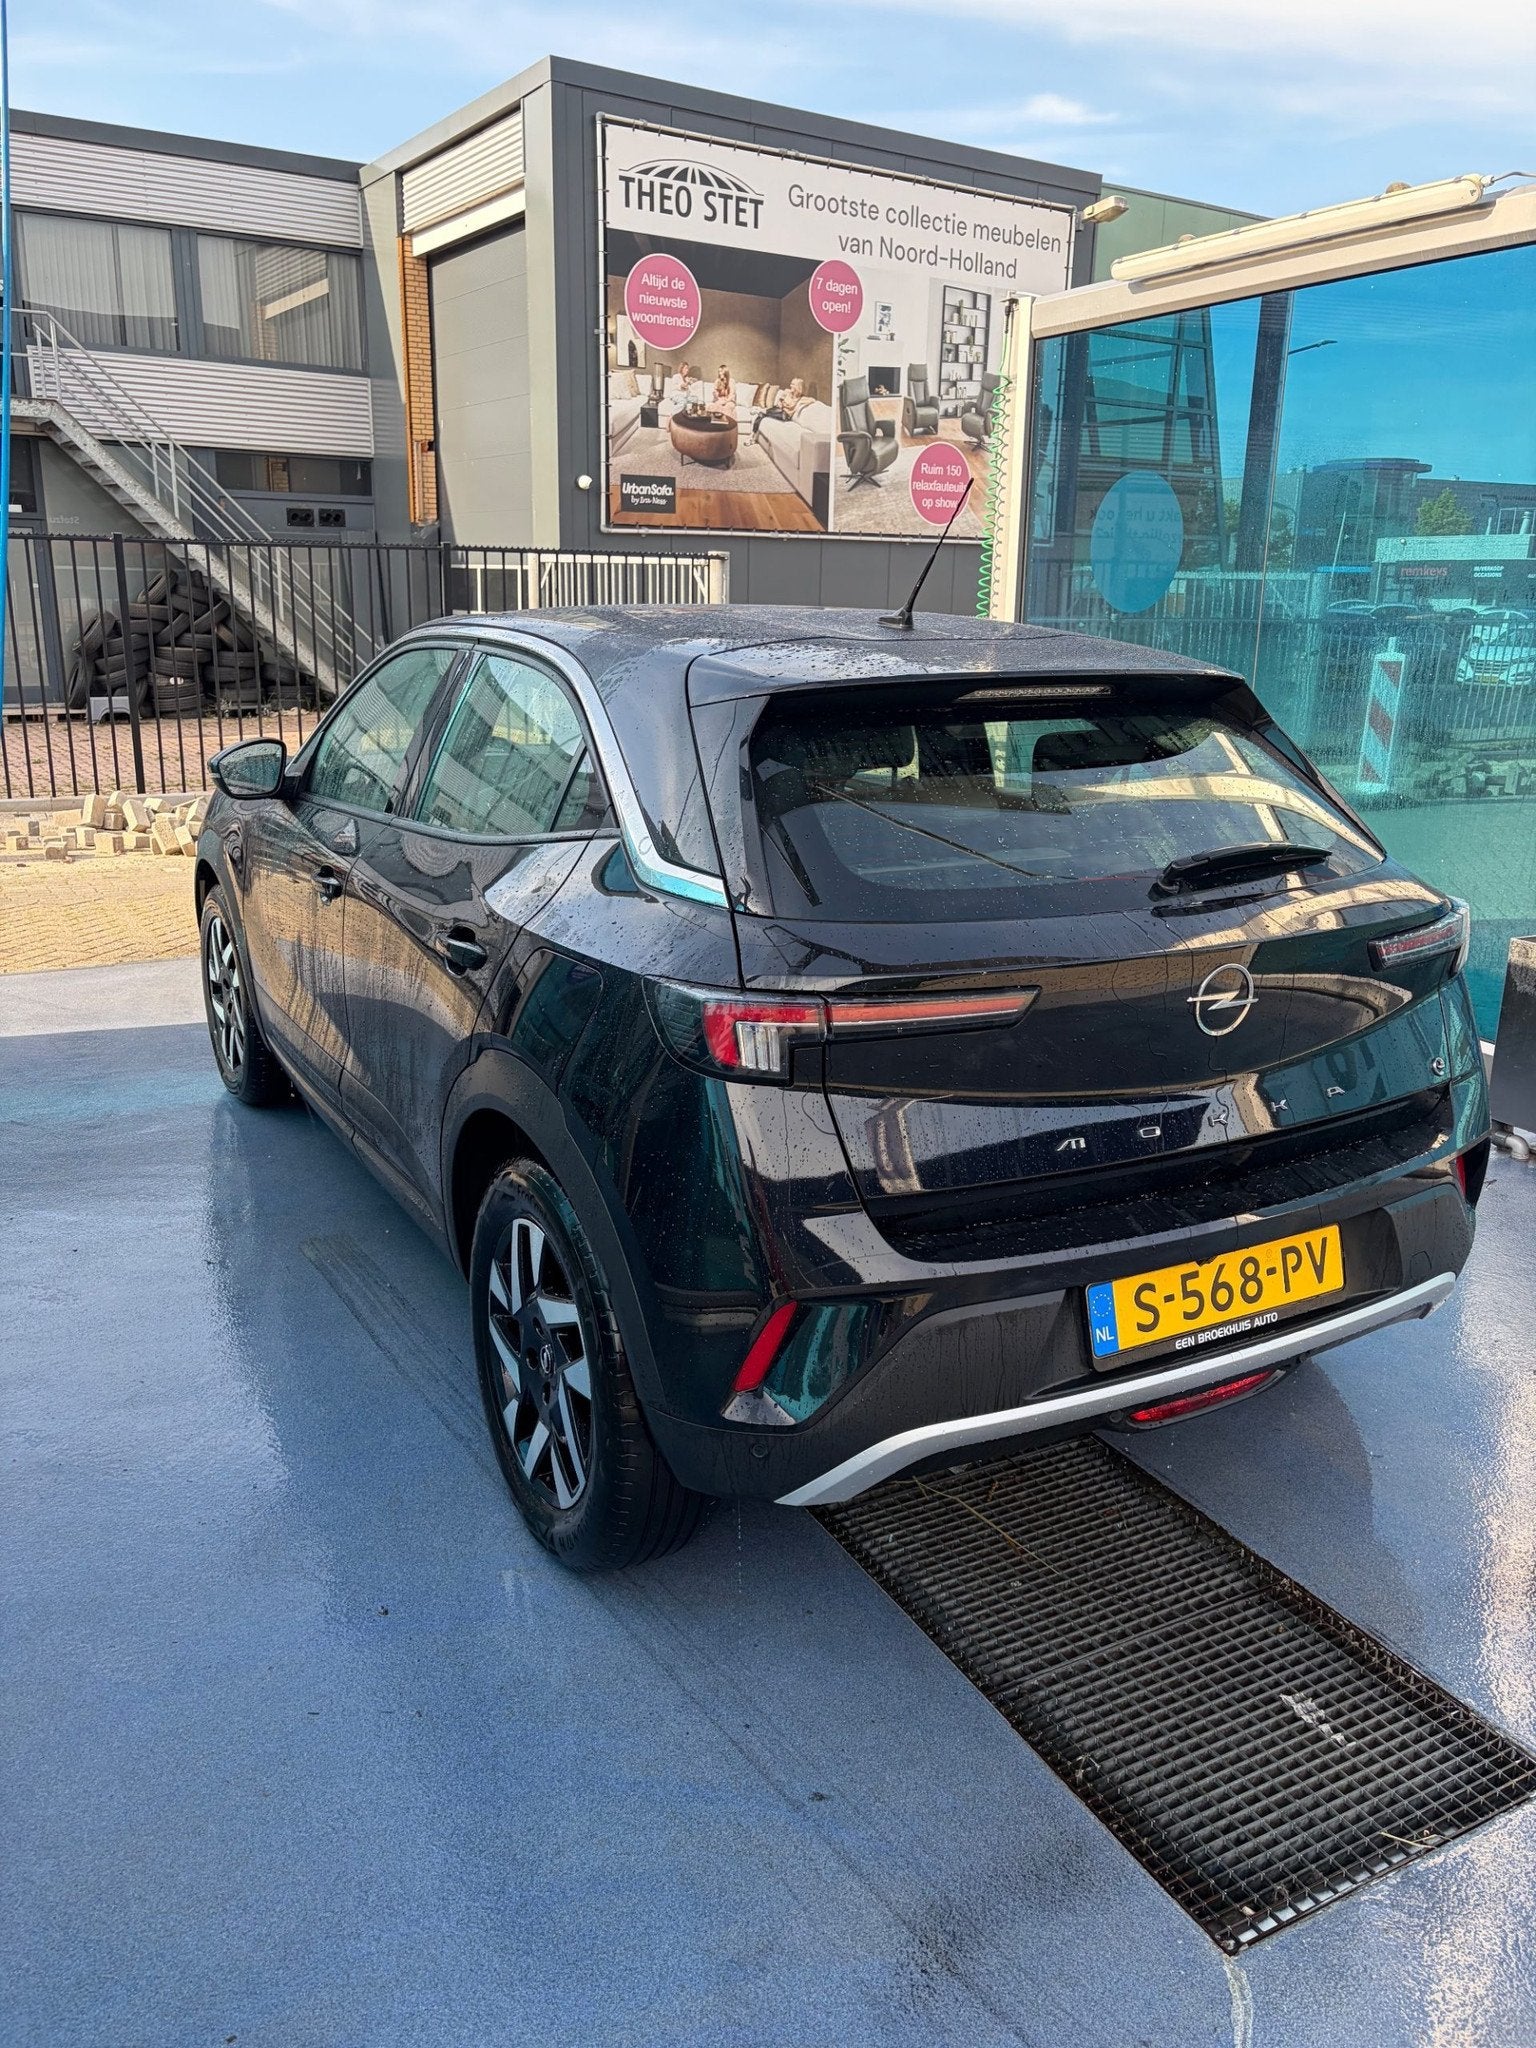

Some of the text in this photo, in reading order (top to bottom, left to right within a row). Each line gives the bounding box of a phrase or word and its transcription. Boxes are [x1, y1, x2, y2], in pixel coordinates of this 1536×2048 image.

[618, 174, 765, 230] THEO STET
[787, 183, 1062, 254] Grootste collectie meubelen
[838, 234, 1018, 280] van Noord-Holland
[641, 272, 686, 291] Altijd de
[816, 276, 858, 297] 7 dagen
[638, 291, 688, 309] nieuwste
[821, 300, 852, 314] open!
[631, 311, 694, 328] woontrends!
[920, 462, 962, 477] Ruim 150
[630, 495, 640, 505] by
[921, 496, 960, 509] op show
[1133, 1236, 1328, 1334] S-568-PV
[1095, 1327, 1115, 1344] NL
[1174, 1311, 1279, 1351] EEN BROEKHUIS AUTO
